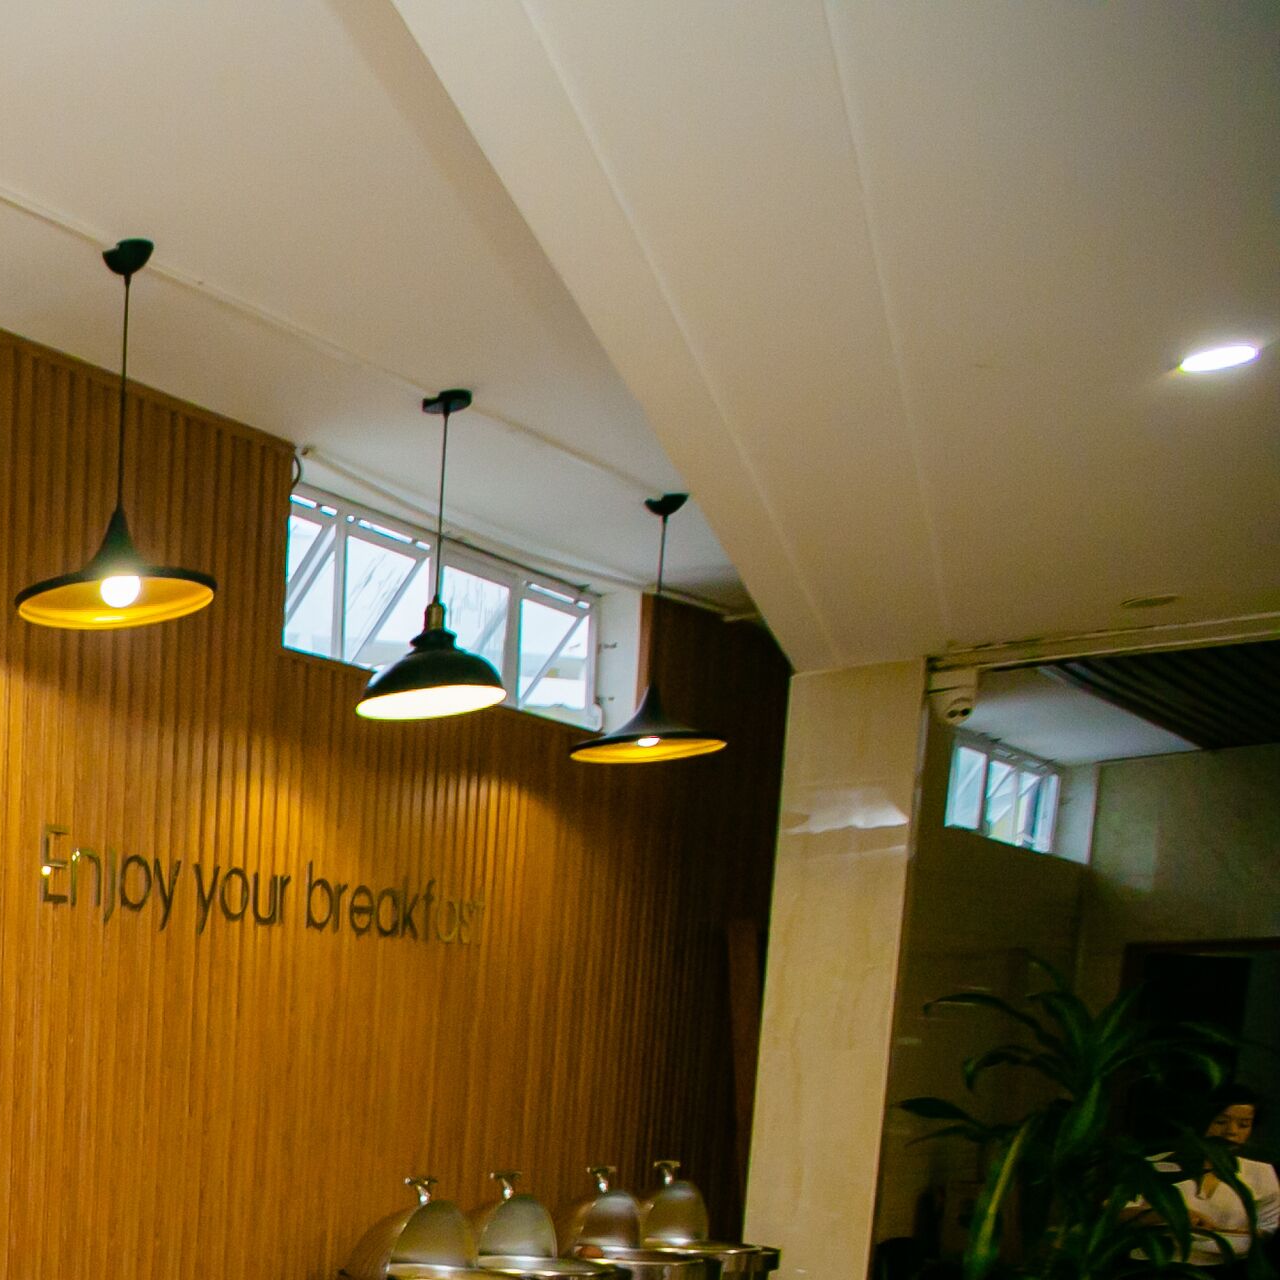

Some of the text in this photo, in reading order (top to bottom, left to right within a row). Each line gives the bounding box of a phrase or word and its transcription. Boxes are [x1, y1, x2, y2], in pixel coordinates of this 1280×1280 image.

[41, 824, 484, 944] Enjoy your breakfast
